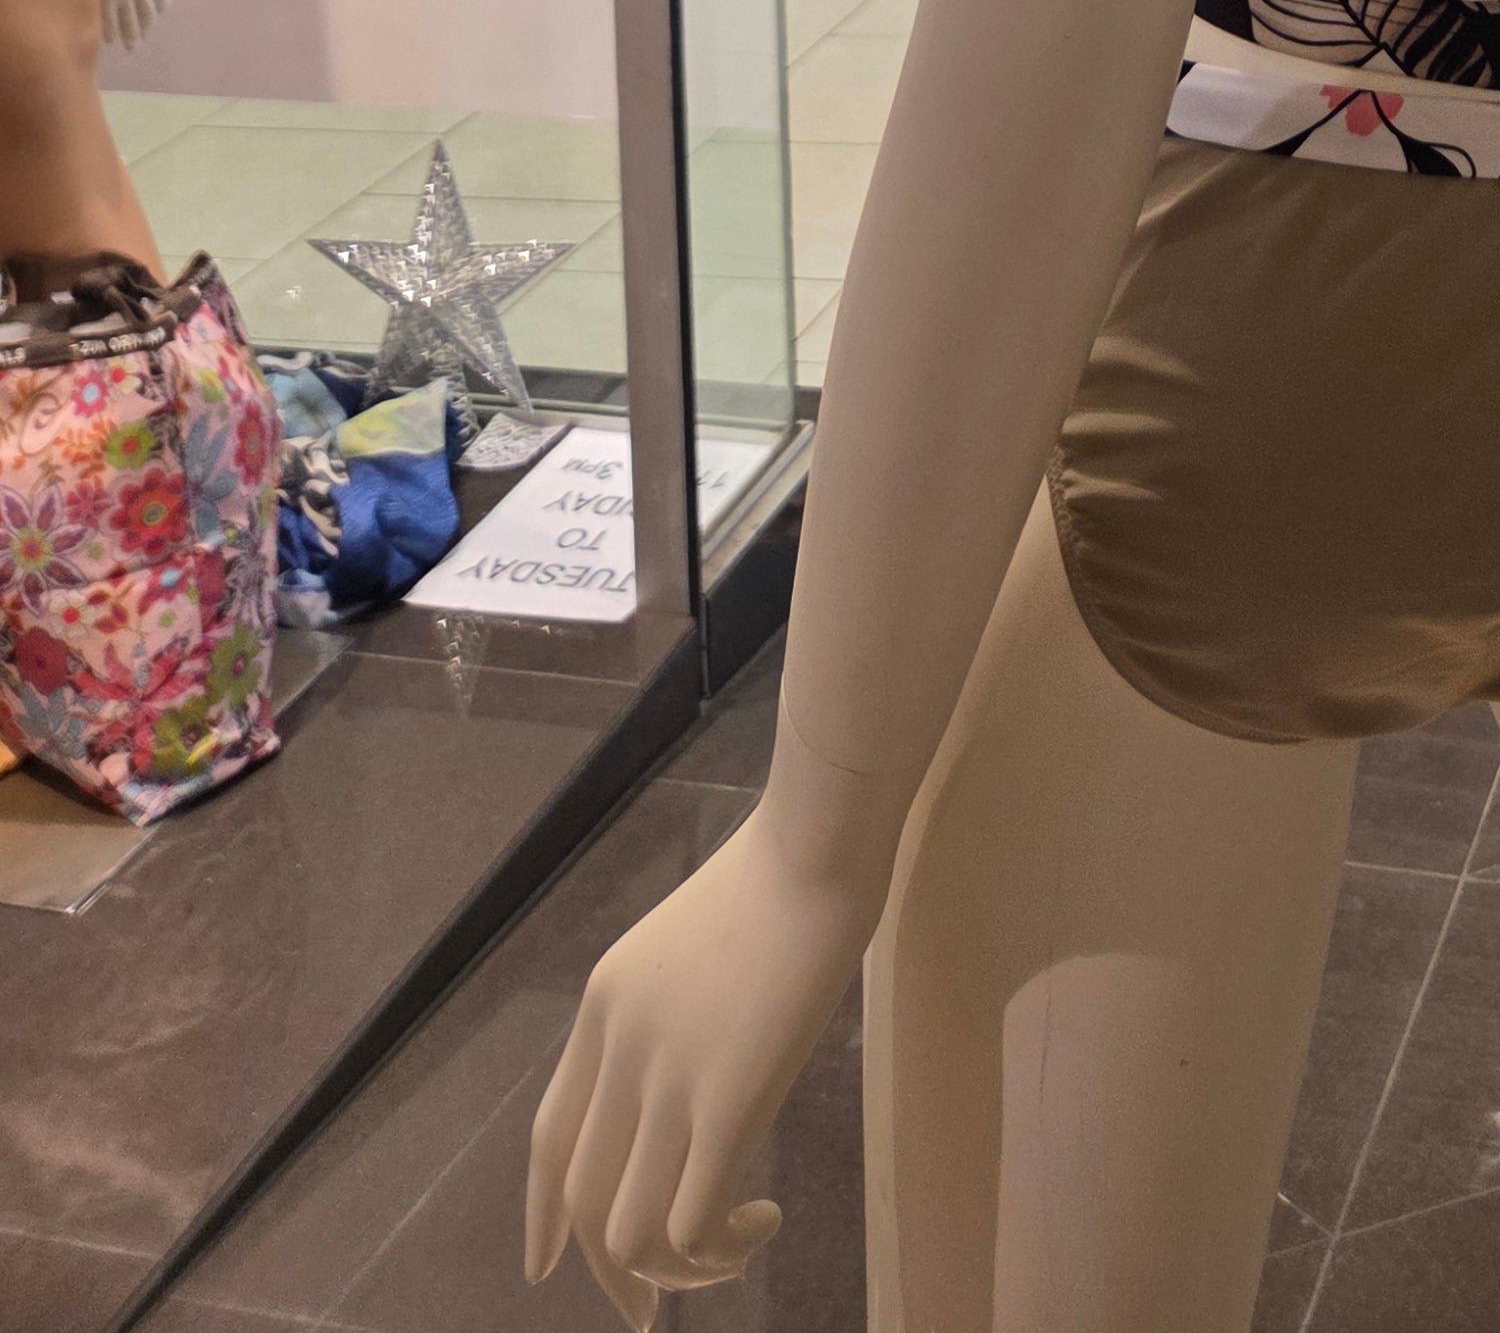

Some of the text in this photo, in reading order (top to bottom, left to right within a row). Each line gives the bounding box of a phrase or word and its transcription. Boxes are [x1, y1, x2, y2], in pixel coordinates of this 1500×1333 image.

[561, 458, 626, 481] 3PM
[542, 490, 634, 517] IDAY
[557, 527, 607, 551] TO
[456, 555, 636, 593] TUESDAY
